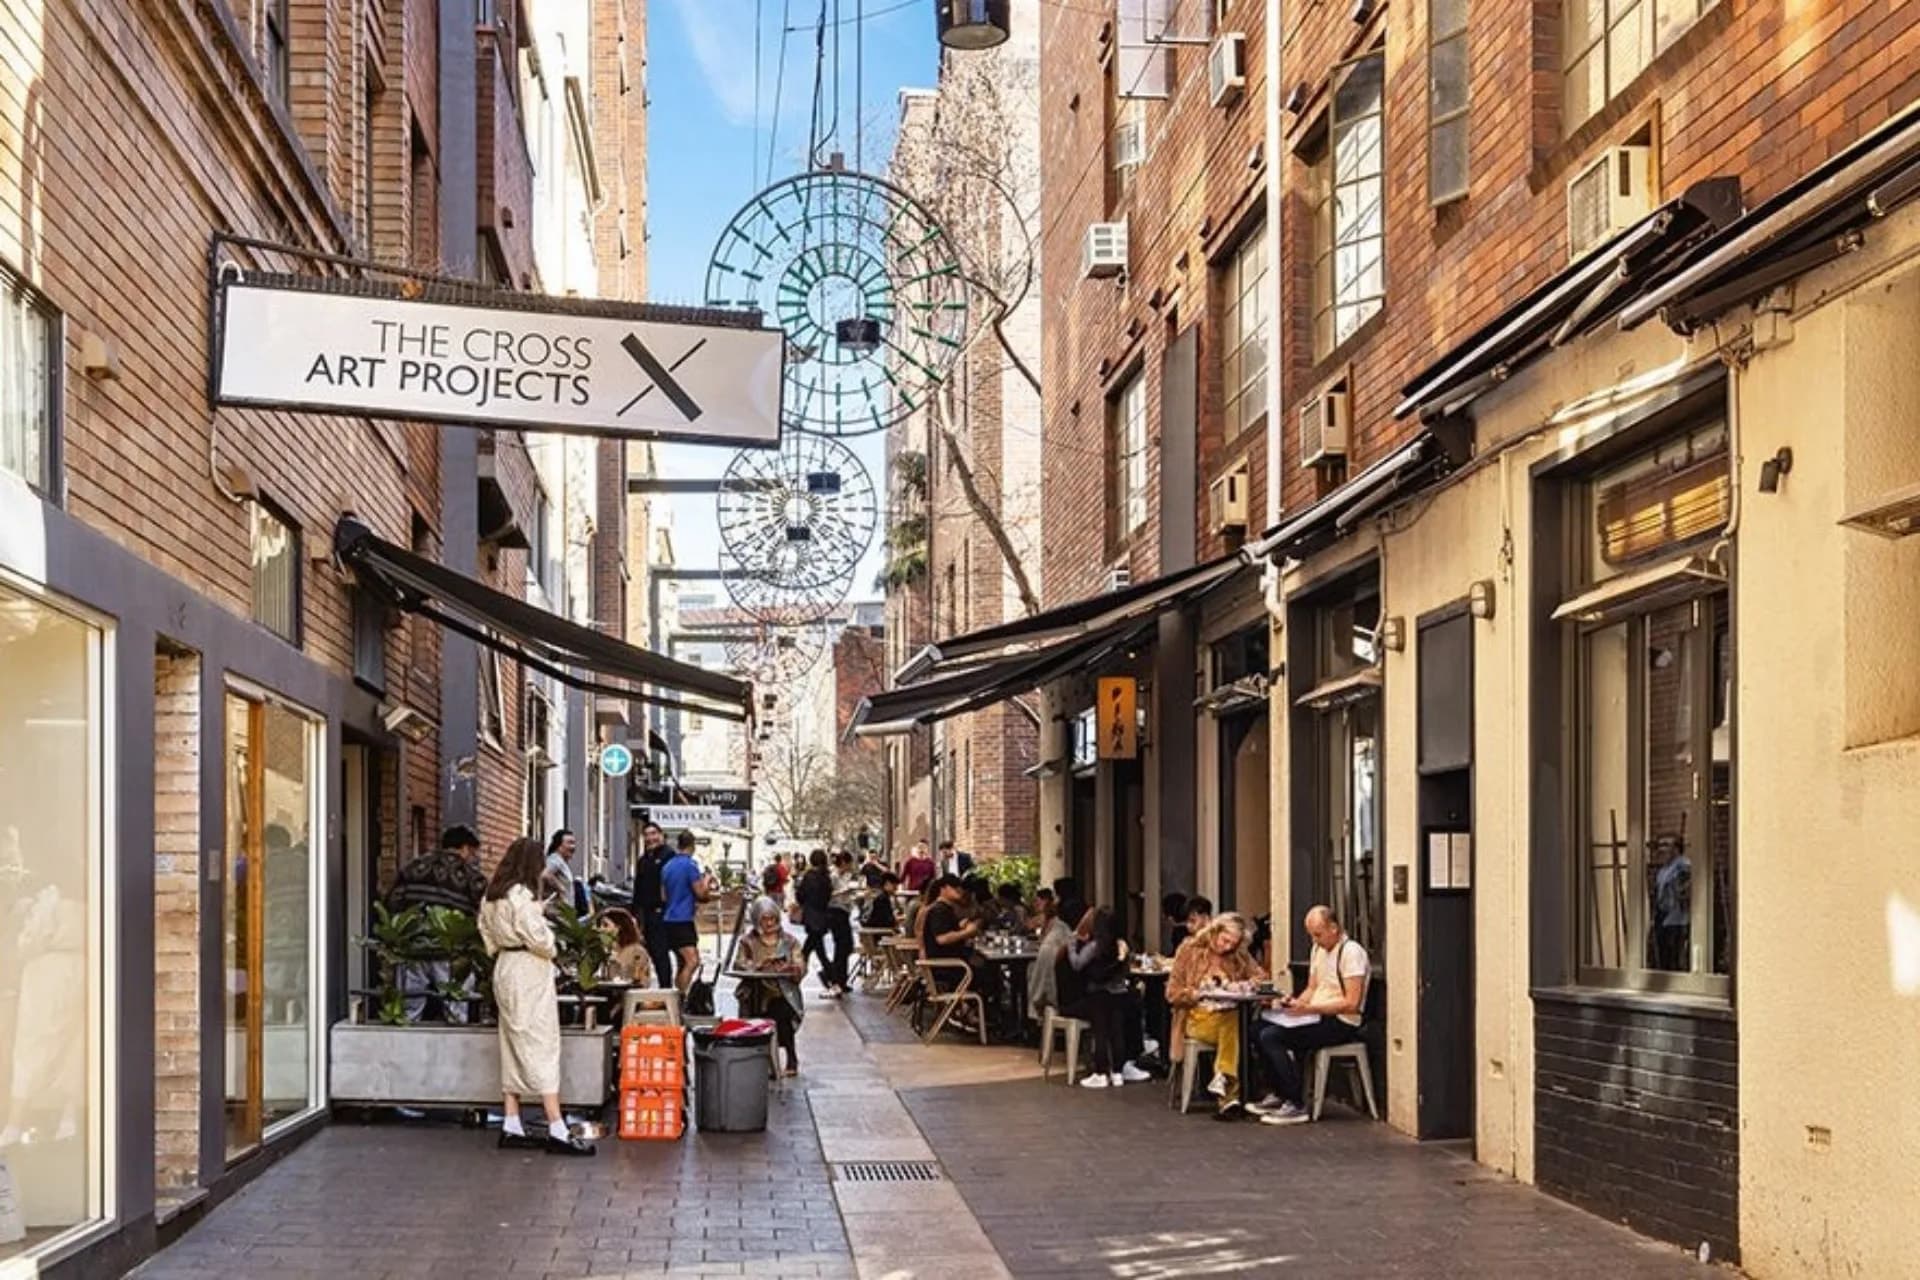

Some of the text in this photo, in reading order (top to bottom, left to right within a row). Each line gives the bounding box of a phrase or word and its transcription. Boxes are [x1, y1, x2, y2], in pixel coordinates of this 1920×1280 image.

[371, 319, 593, 371] THE CROSS
[305, 353, 591, 407] ART PROJECTS
